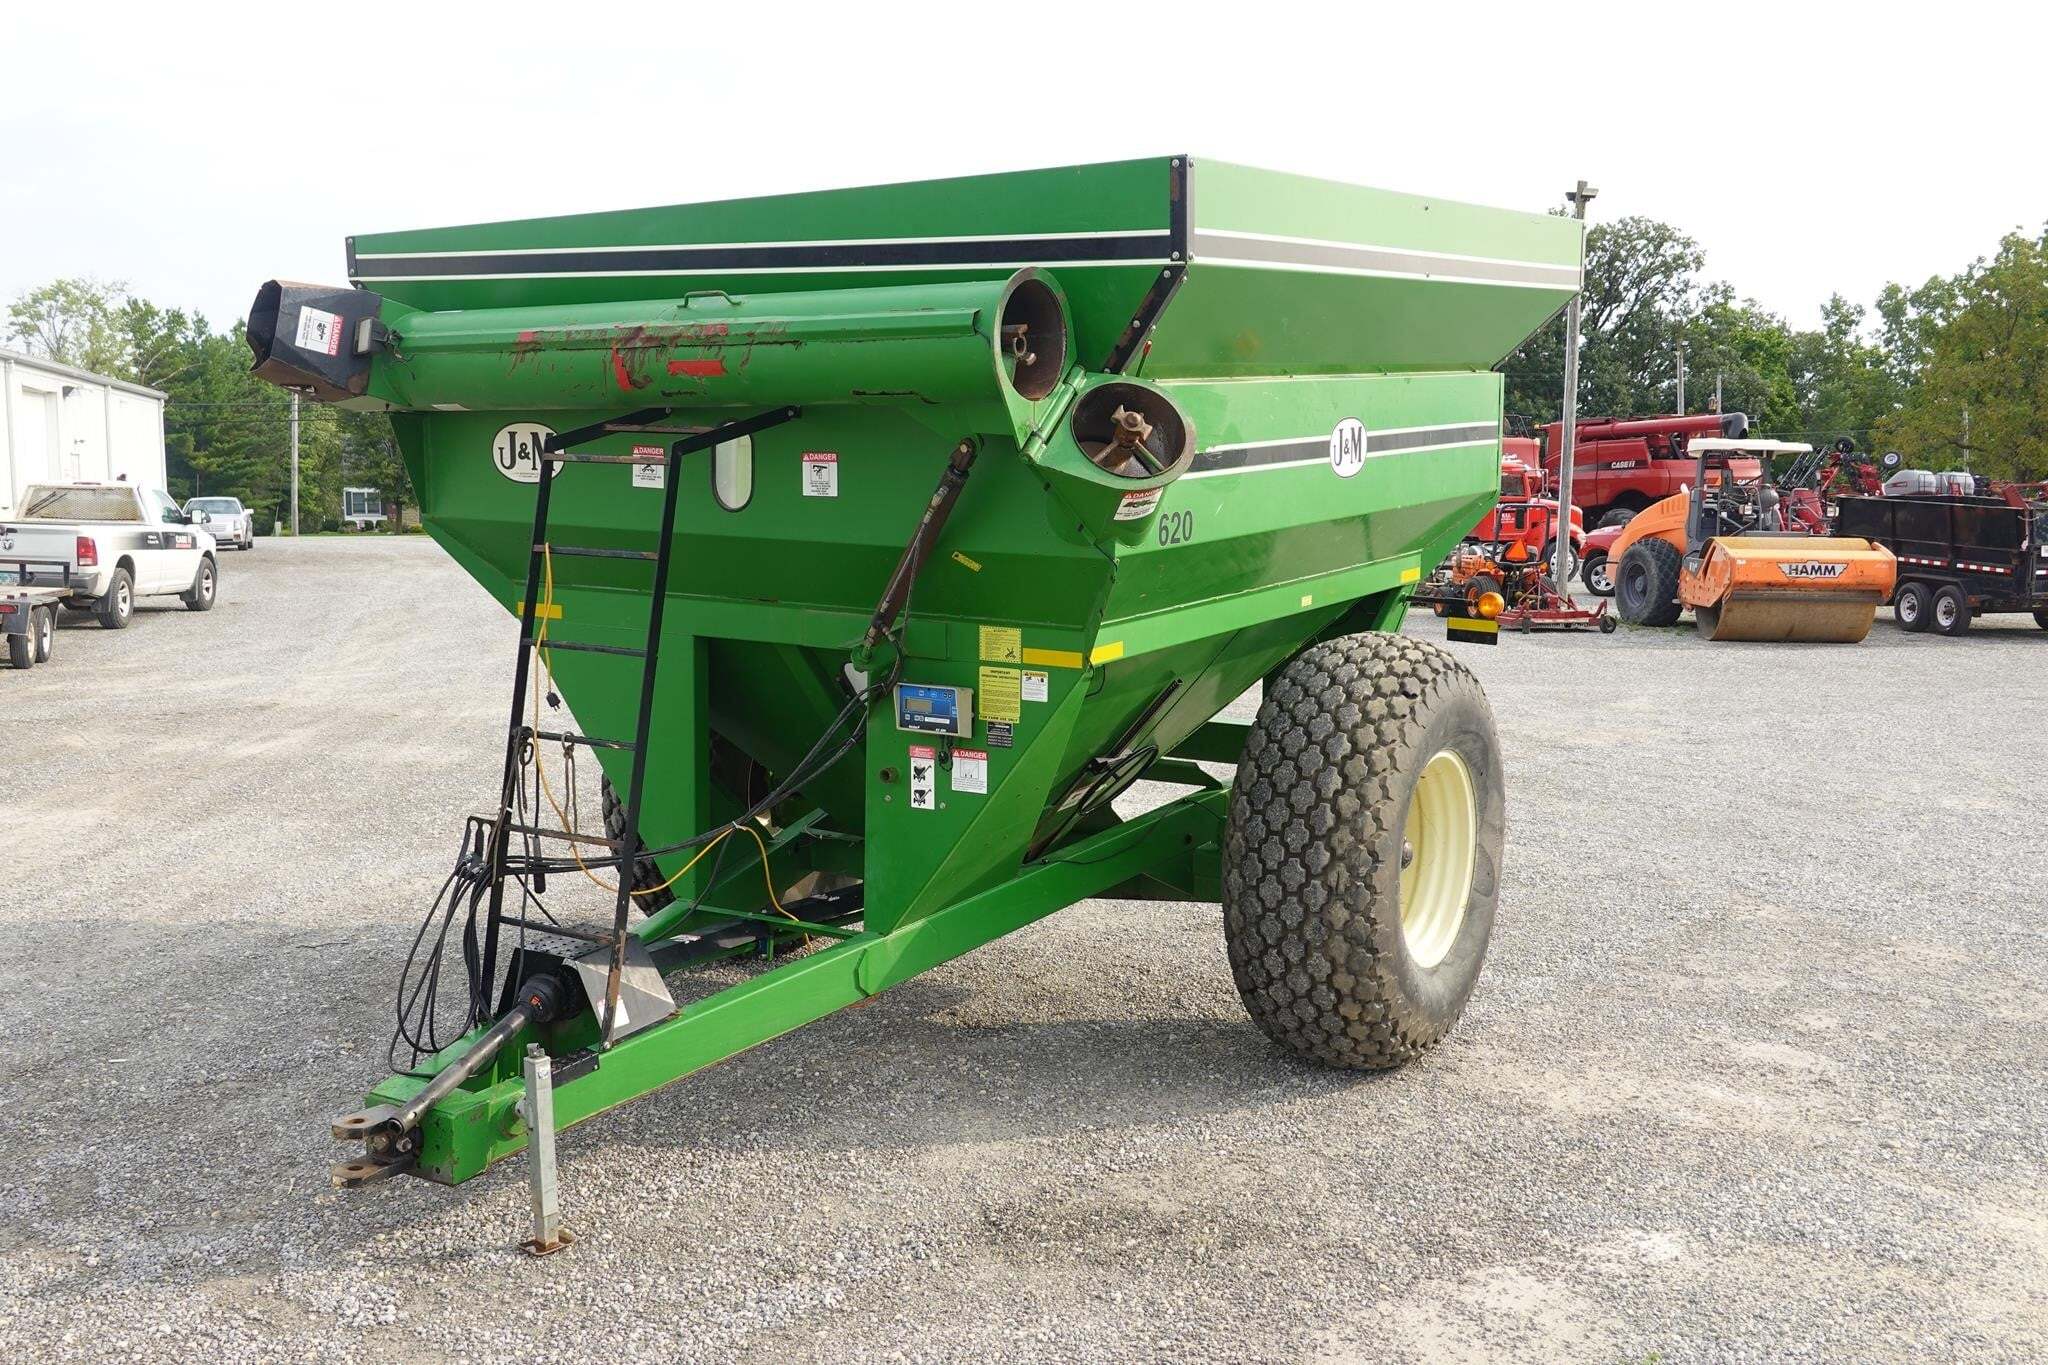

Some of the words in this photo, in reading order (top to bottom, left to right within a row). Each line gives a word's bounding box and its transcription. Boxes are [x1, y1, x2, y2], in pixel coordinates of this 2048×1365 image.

[329, 322, 341, 355] DANGER
[498, 431, 557, 471] J&M
[638, 447, 664, 456] DANGER
[1333, 426, 1363, 467] J&M
[809, 453, 837, 461] DANGER
[1611, 461, 1629, 469] CASE
[1158, 510, 1193, 546] 620
[1788, 563, 1836, 577] HAMM
[960, 750, 987, 759] DANGER
